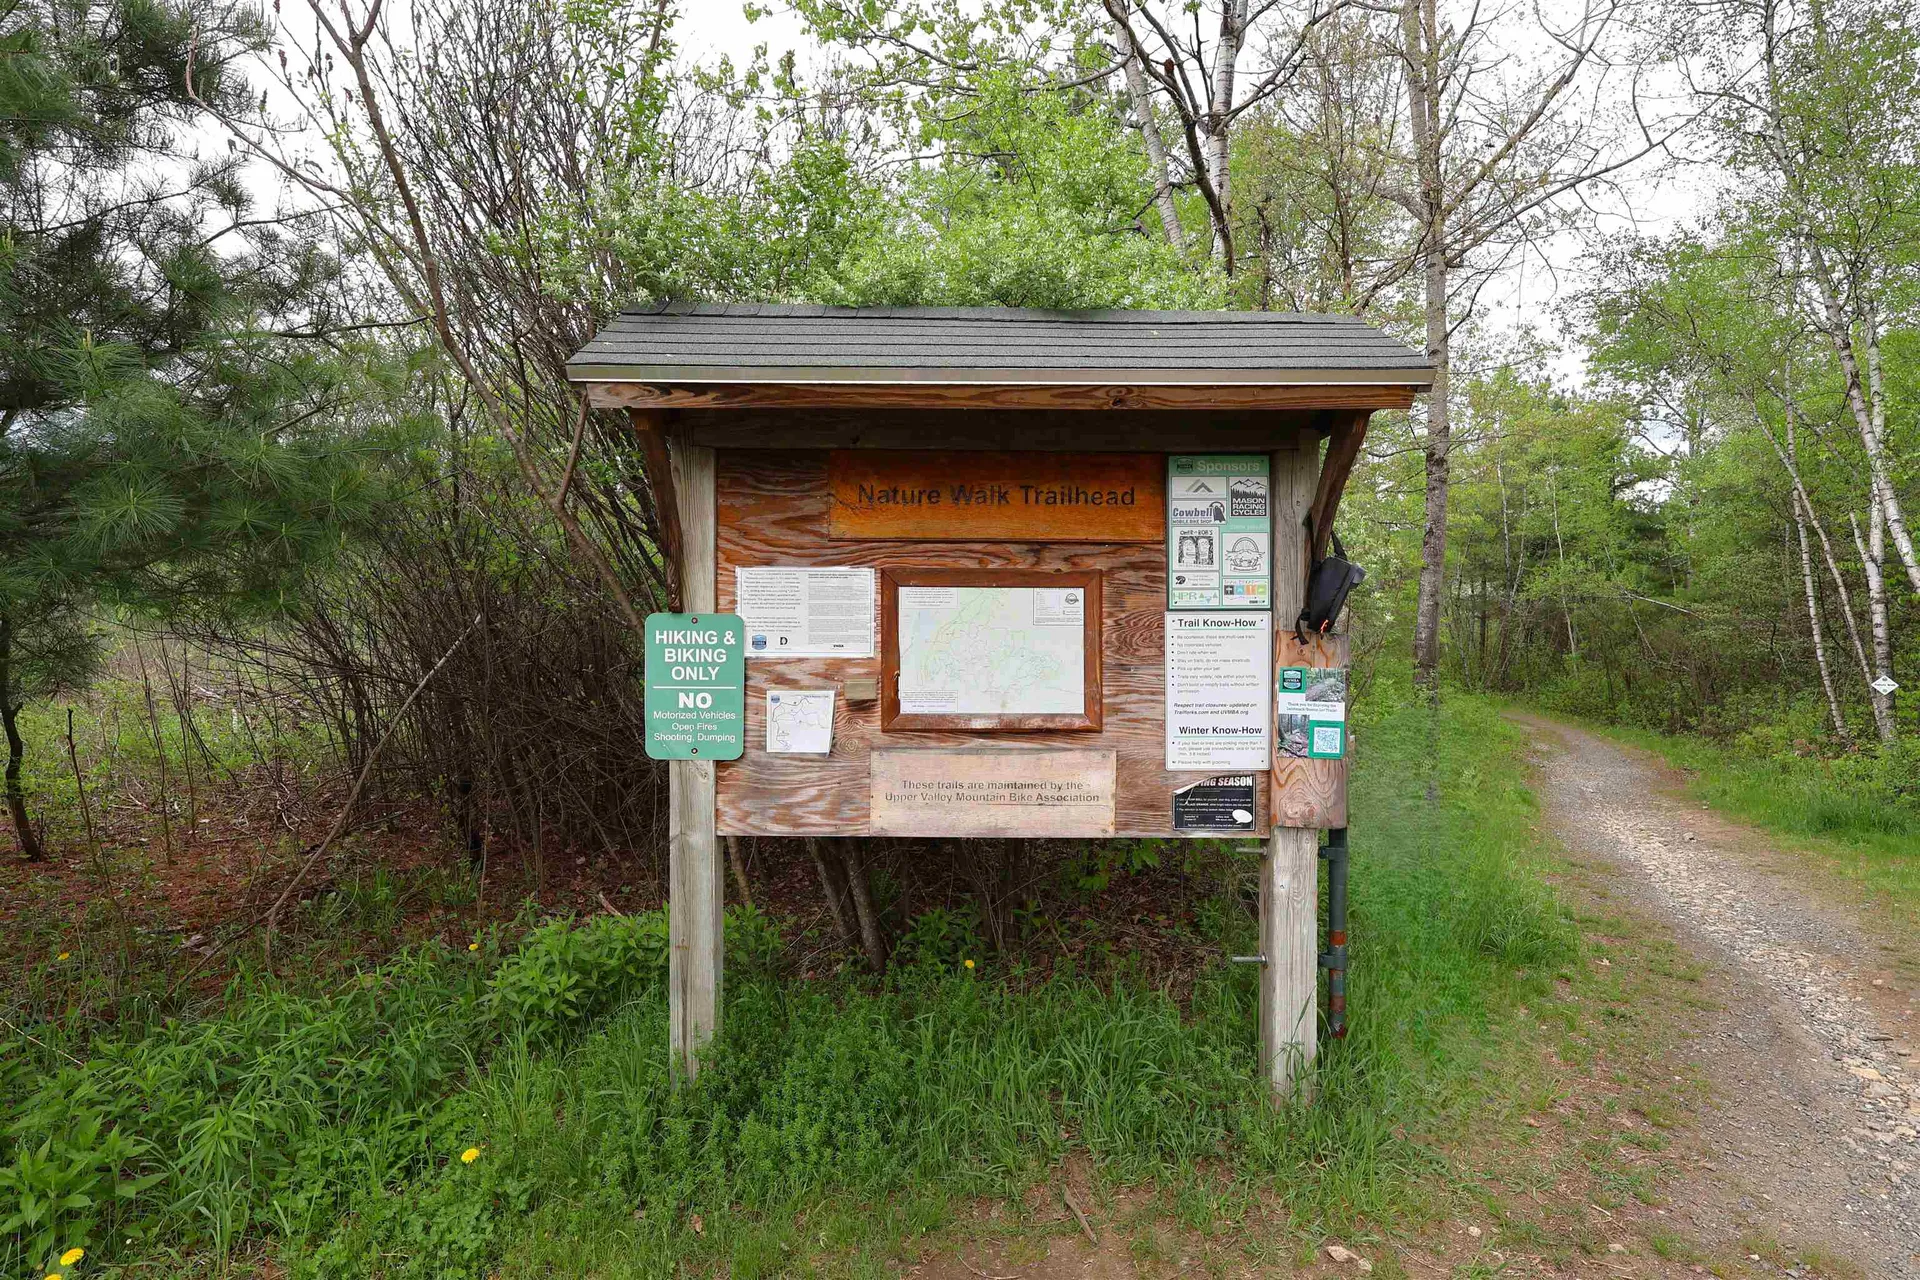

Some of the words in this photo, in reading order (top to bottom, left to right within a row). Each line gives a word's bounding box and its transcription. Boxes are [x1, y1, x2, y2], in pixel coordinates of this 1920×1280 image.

[1197, 460, 1259, 473] Sponsors
[857, 484, 941, 506] Nature
[949, 484, 1010, 506] Walk
[1018, 484, 1136, 506] Trailhead
[1172, 508, 1212, 516] Cowbell
[1178, 618, 1200, 627] Trail
[1202, 618, 1256, 627] Know-How
[655, 630, 718, 645] HIKING
[723, 630, 736, 645] &
[664, 648, 727, 663] BIKING
[671, 666, 720, 680] ONLY
[678, 692, 712, 709] NO
[653, 711, 696, 719] Motorized
[700, 711, 736, 719] Vehicles
[672, 723, 694, 732] Open
[654, 733, 694, 743] Shooting,
[698, 733, 736, 743] Dumping
[902, 780, 934, 790] These
[937, 780, 964, 790] trails
[987, 780, 1047, 790] maintained
[1050, 780, 1064, 791] by
[1066, 780, 1083, 790] the
[1217, 776, 1252, 786] SEASON
[885, 793, 916, 802] Upper
[920, 793, 952, 803] Valley
[955, 793, 1006, 802] Mountain
[1009, 793, 1032, 802] Bike
[1035, 793, 1100, 802] Association
